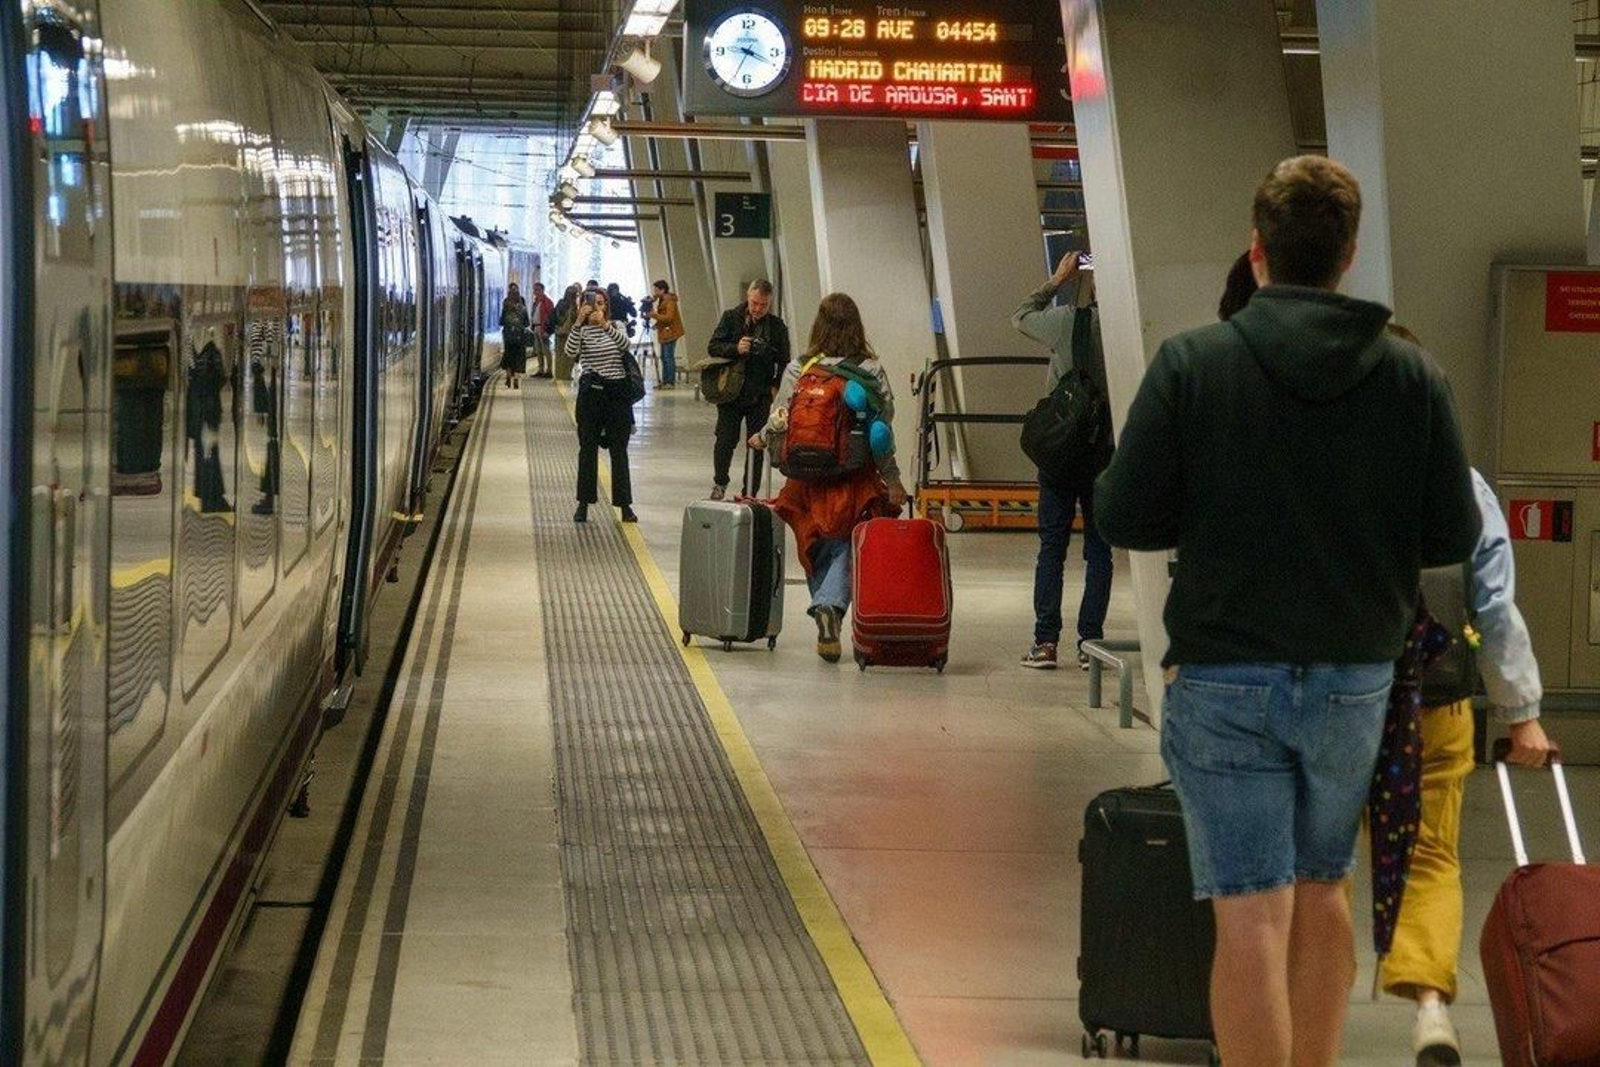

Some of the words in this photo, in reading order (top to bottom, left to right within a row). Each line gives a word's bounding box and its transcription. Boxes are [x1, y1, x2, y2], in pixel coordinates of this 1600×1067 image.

[803, 5, 828, 15] Hora
[877, 5, 901, 16] Tren
[742, 19, 756, 30] 12
[876, 19, 915, 39] AVE
[936, 20, 997, 41] 04454
[716, 46, 725, 56] 9
[770, 47, 779, 57] 3
[802, 46, 836, 57] Destino
[809, 59, 884, 80] MADRID
[892, 61, 1003, 84] CHAMARTIN
[742, 73, 752, 84] 6
[848, 85, 874, 104] DE
[979, 87, 1031, 107] SANT
[721, 213, 735, 236] 3
